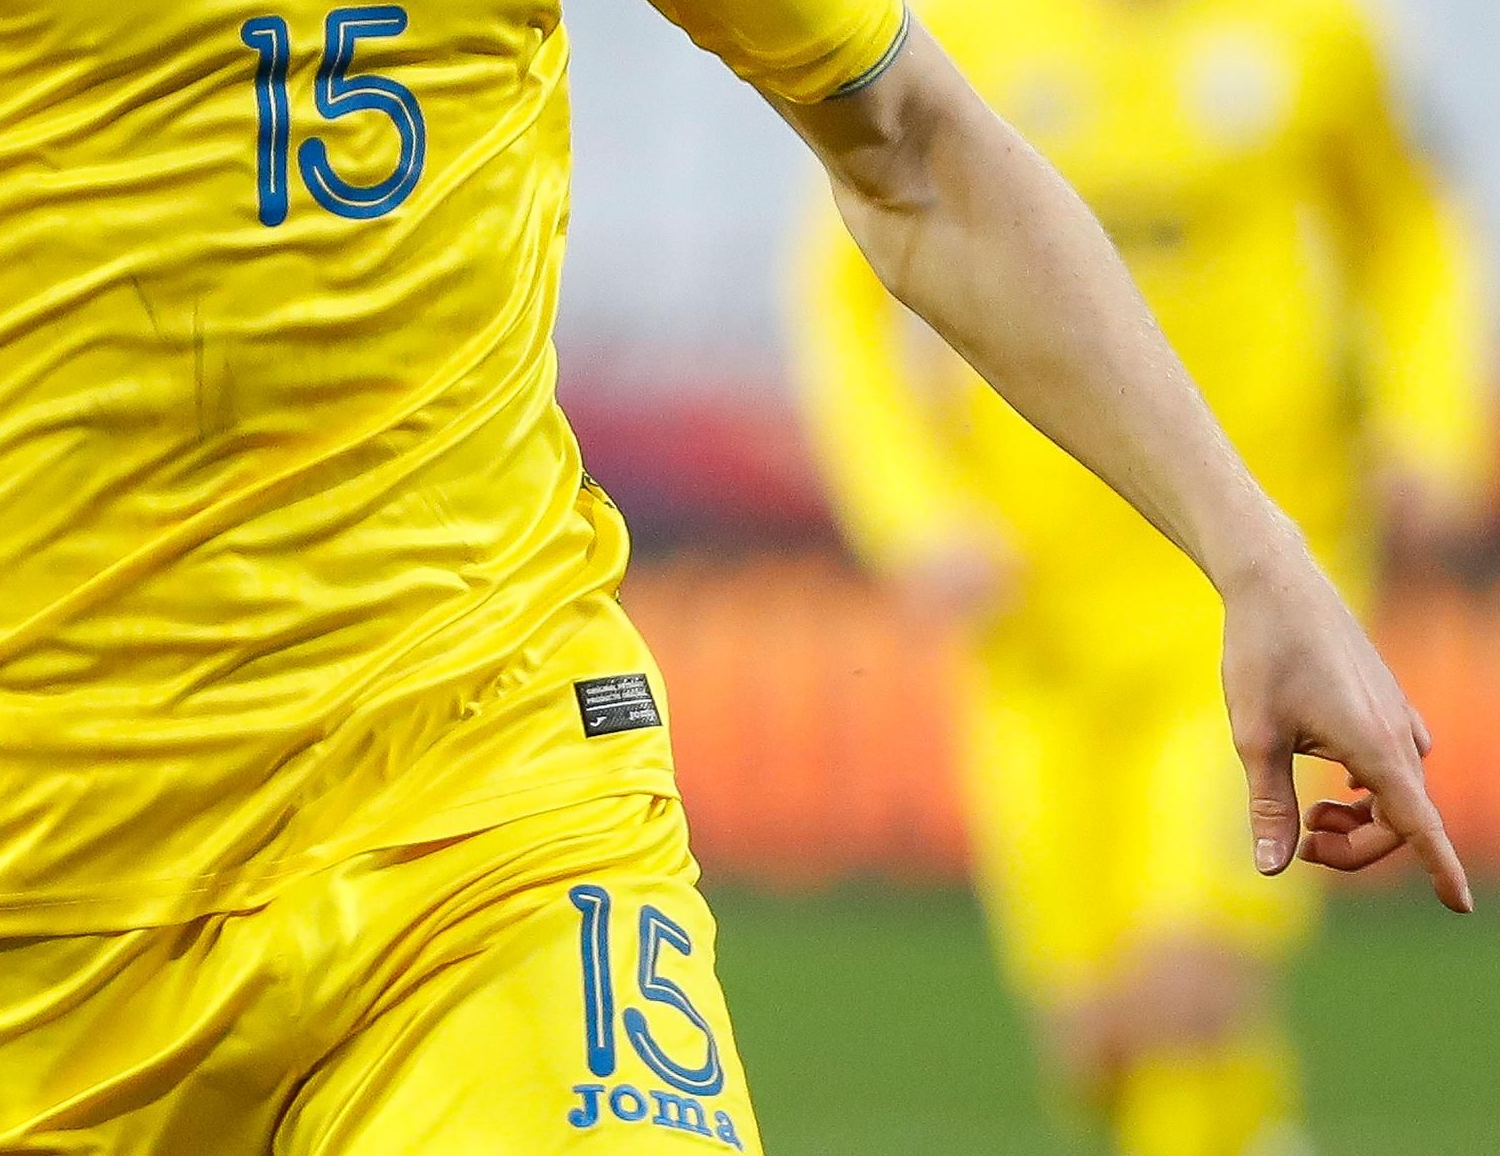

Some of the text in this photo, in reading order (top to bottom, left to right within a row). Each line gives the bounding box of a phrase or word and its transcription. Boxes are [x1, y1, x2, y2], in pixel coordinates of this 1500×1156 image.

[240, 4, 426, 228] 15
[568, 884, 725, 1097] 15
[567, 1083, 743, 1151] Joma
